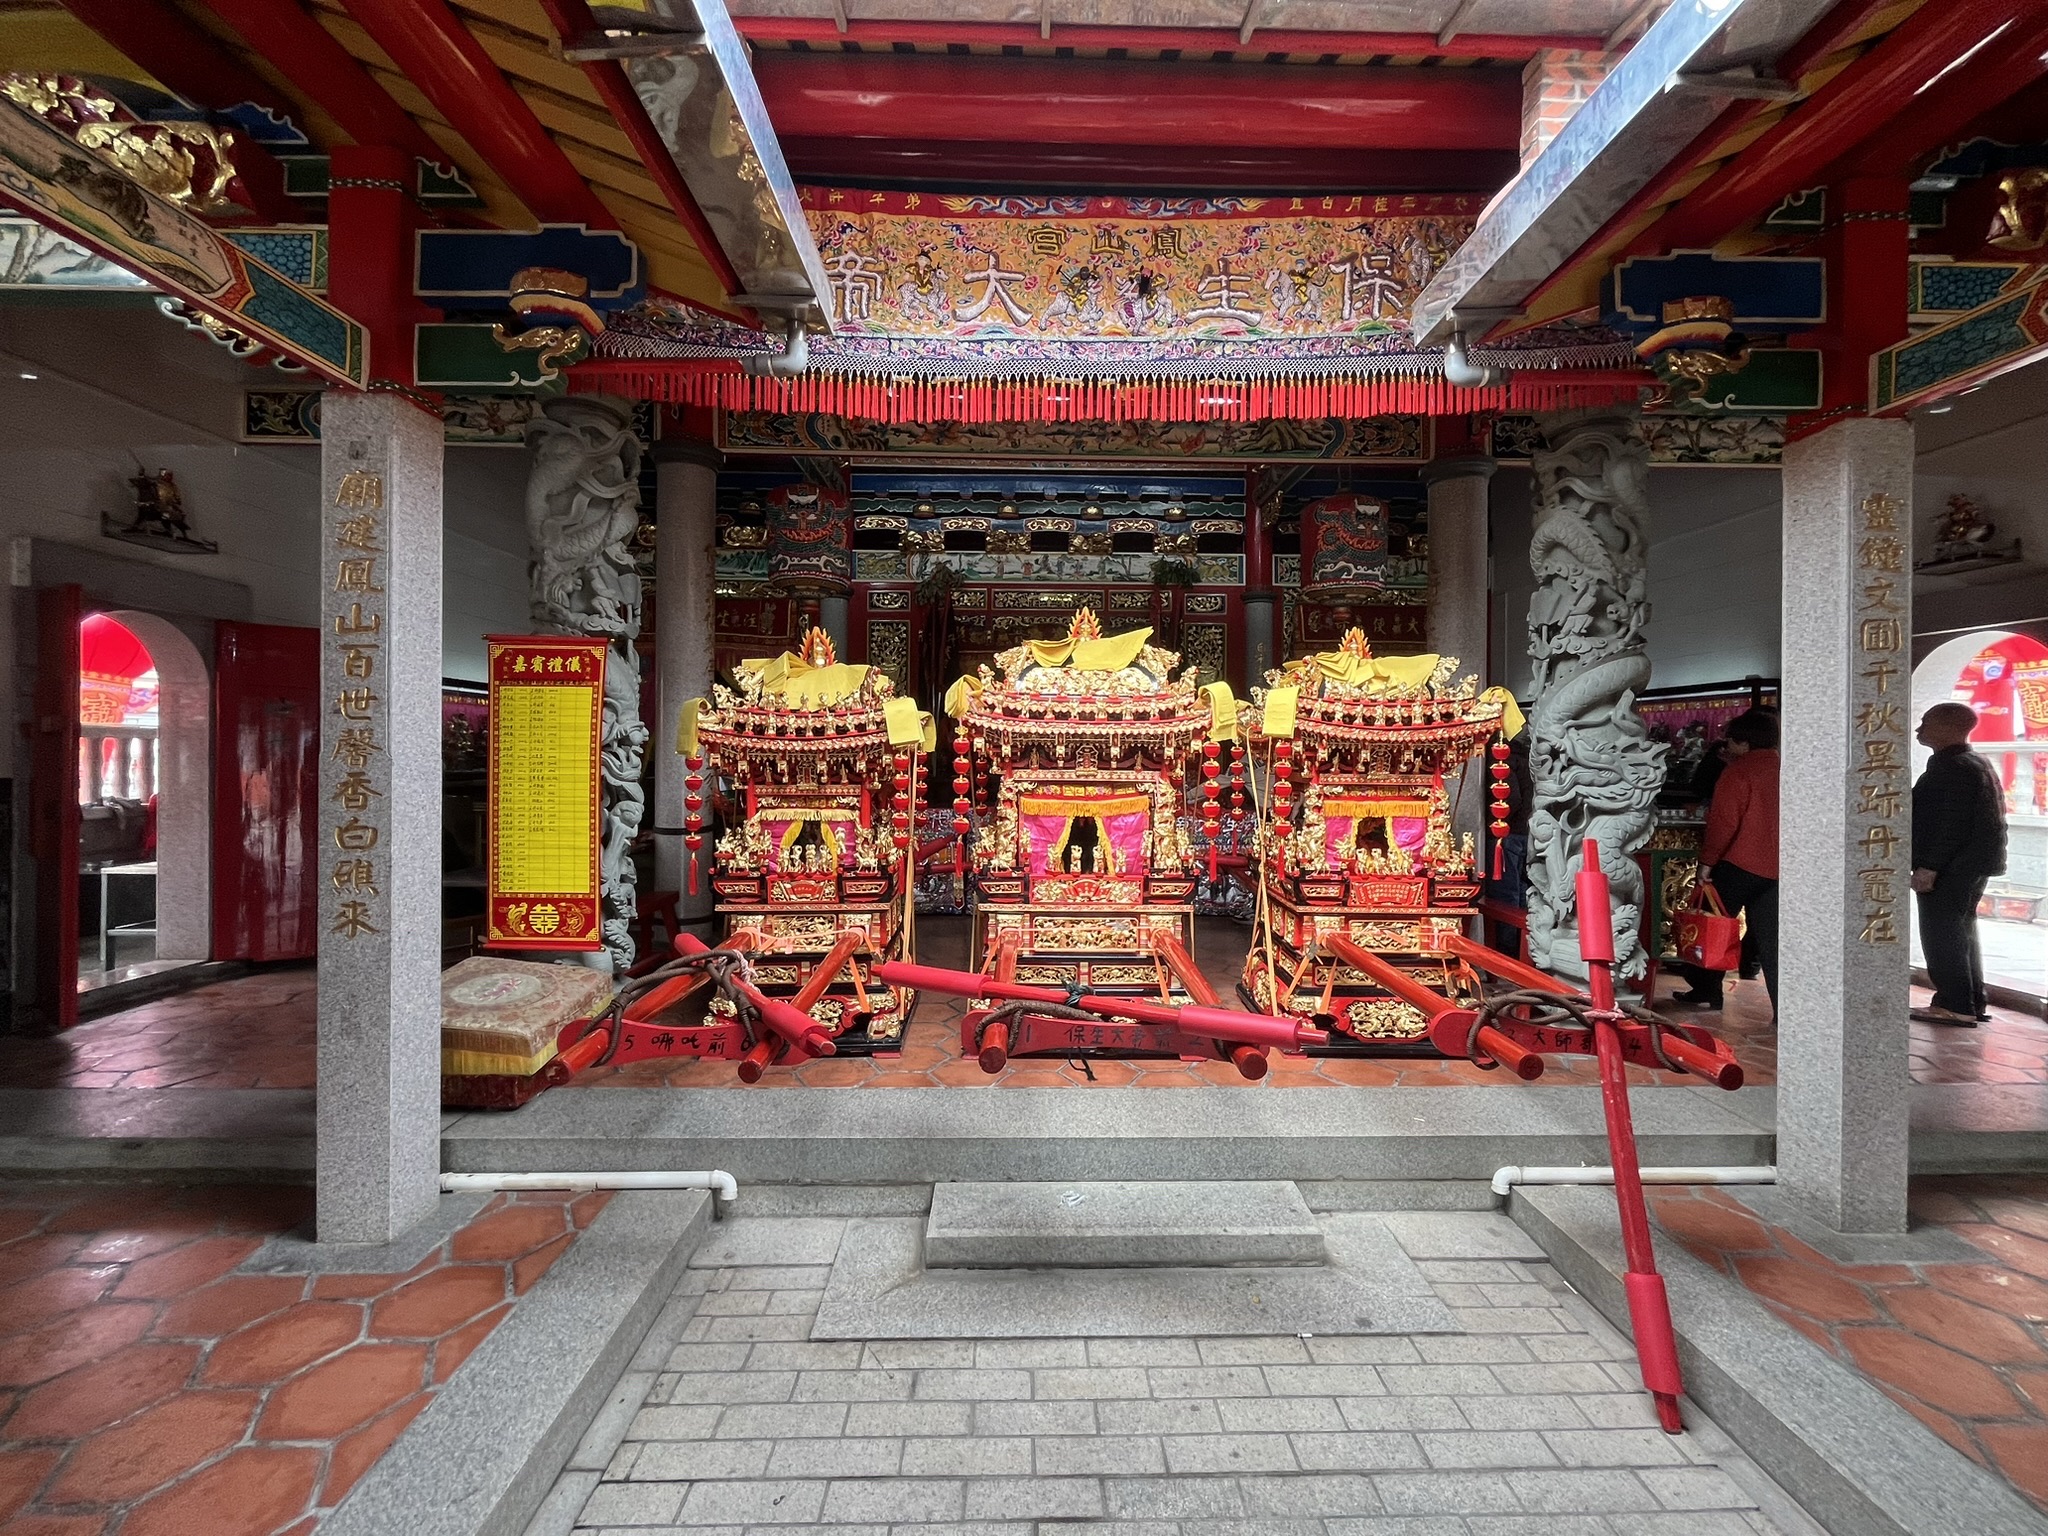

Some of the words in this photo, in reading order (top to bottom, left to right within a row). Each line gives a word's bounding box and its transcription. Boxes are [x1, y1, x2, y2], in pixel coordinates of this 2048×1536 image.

[1027, 226, 1186, 259] 鳳山宮
[825, 250, 1404, 327] 保生大帝
[512, 654, 582, 674] 嘉賓禮儀
[624, 1034, 636, 1052] 5
